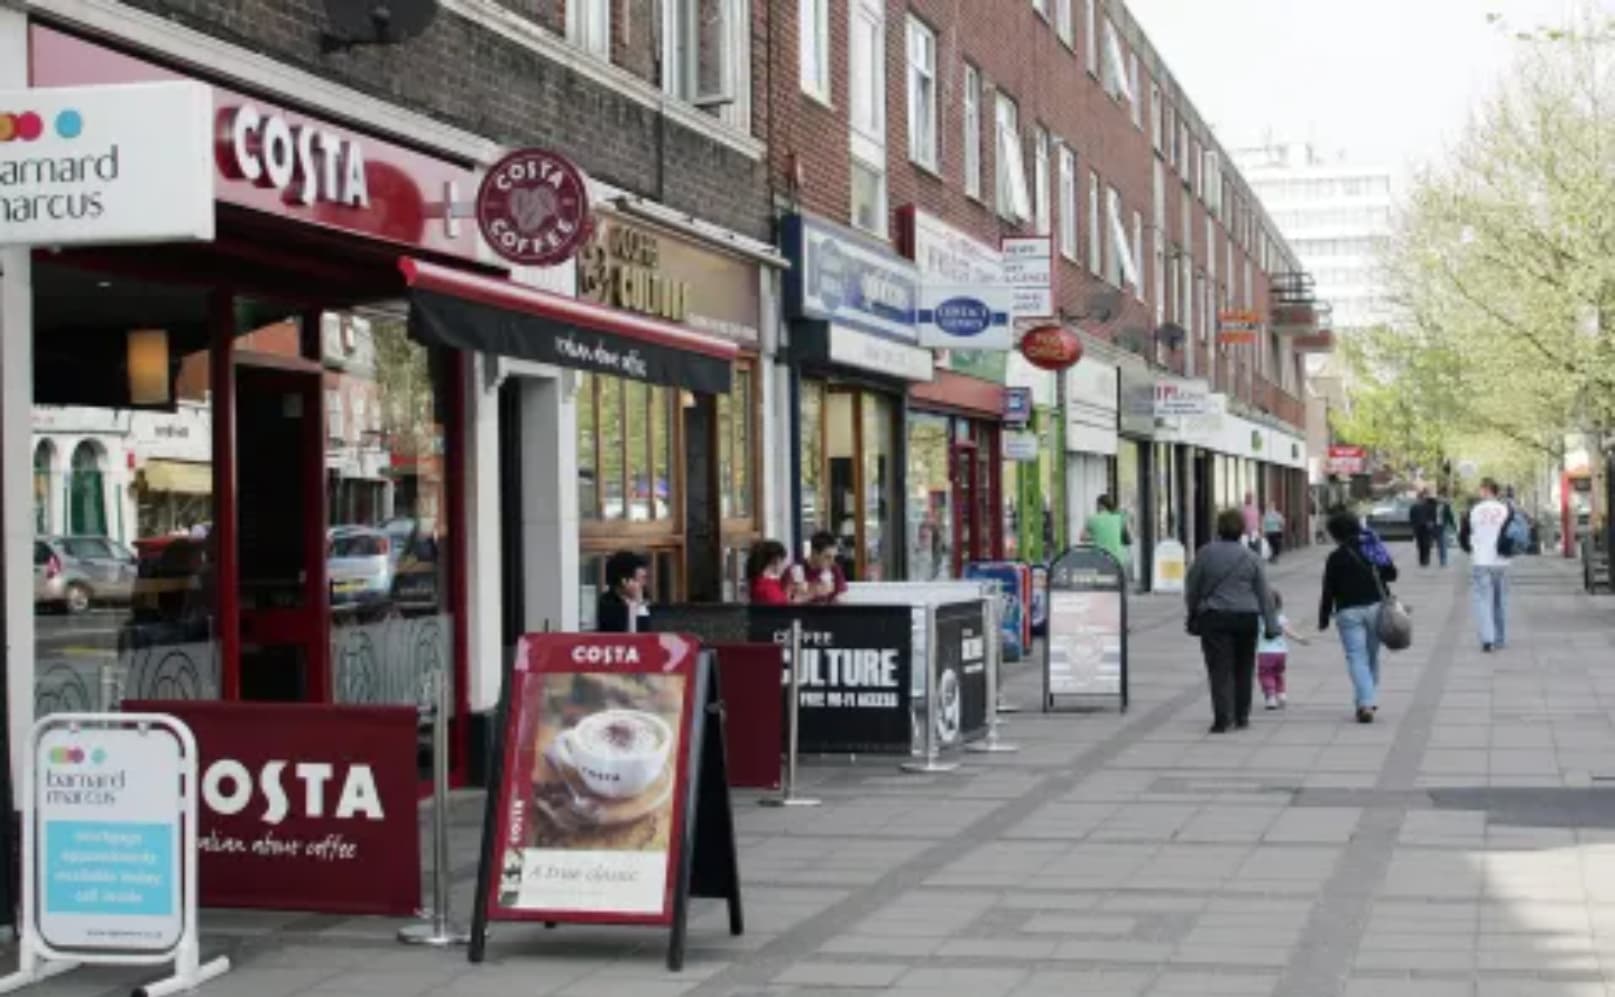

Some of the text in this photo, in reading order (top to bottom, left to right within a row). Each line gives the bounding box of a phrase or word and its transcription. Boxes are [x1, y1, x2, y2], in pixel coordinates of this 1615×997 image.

[0, 144, 119, 185] arnard
[234, 102, 370, 208] COSTA
[496, 160, 563, 190] COSTA
[490, 218, 573, 254] COFFEE
[571, 645, 641, 664] COSTA
[46, 769, 126, 789] barnard
[200, 758, 385, 825] OSTA
[46, 789, 117, 805] marcus
[305, 832, 358, 861] coffee
